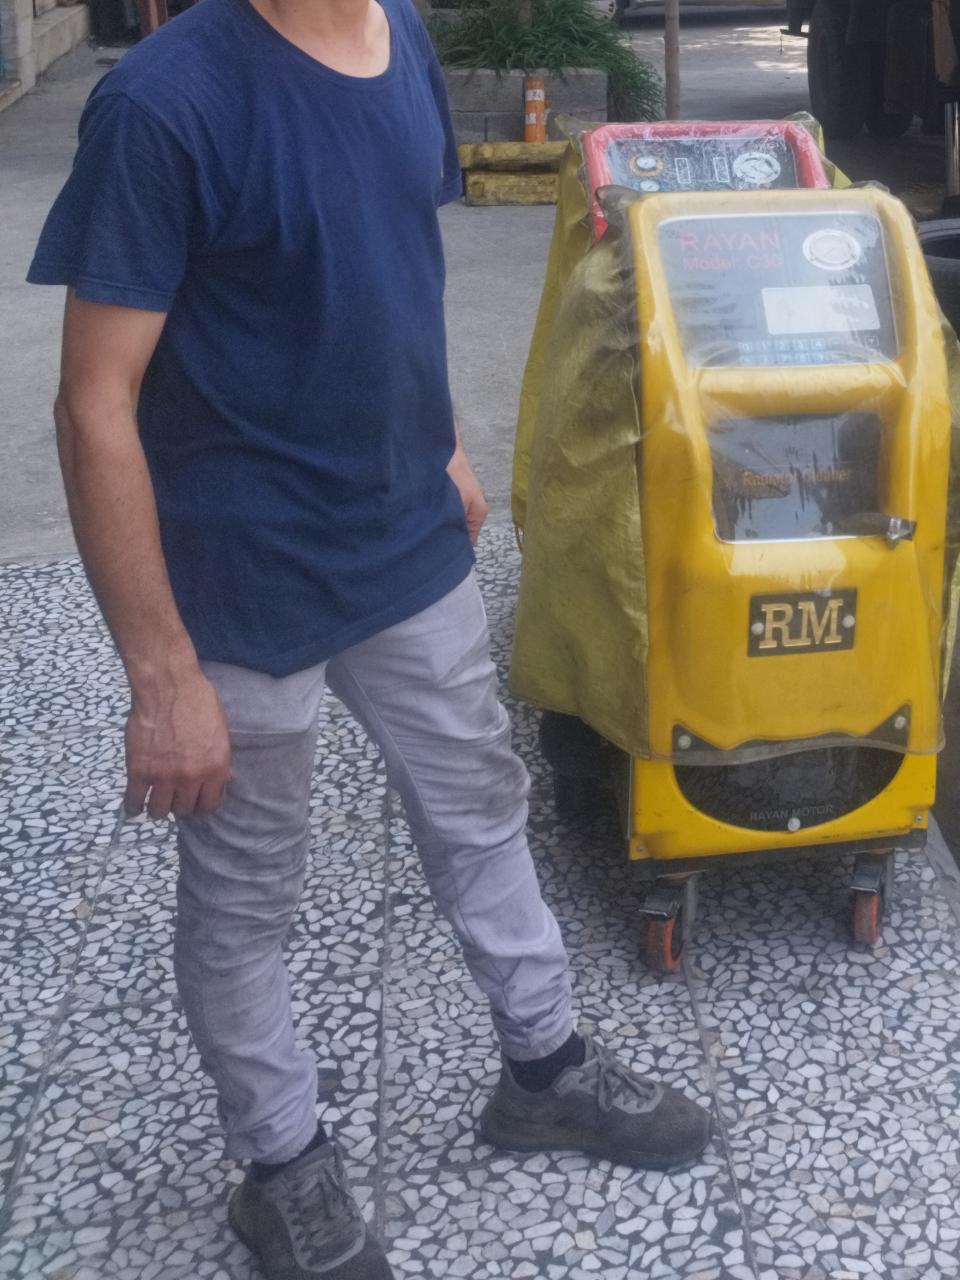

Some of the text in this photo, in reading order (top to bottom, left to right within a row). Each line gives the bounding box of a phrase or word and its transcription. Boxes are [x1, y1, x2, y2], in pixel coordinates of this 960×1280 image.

[680, 230, 780, 251] RAYAN
[758, 598, 844, 649] RM
[752, 804, 833, 822] RAYAN MOTOR
